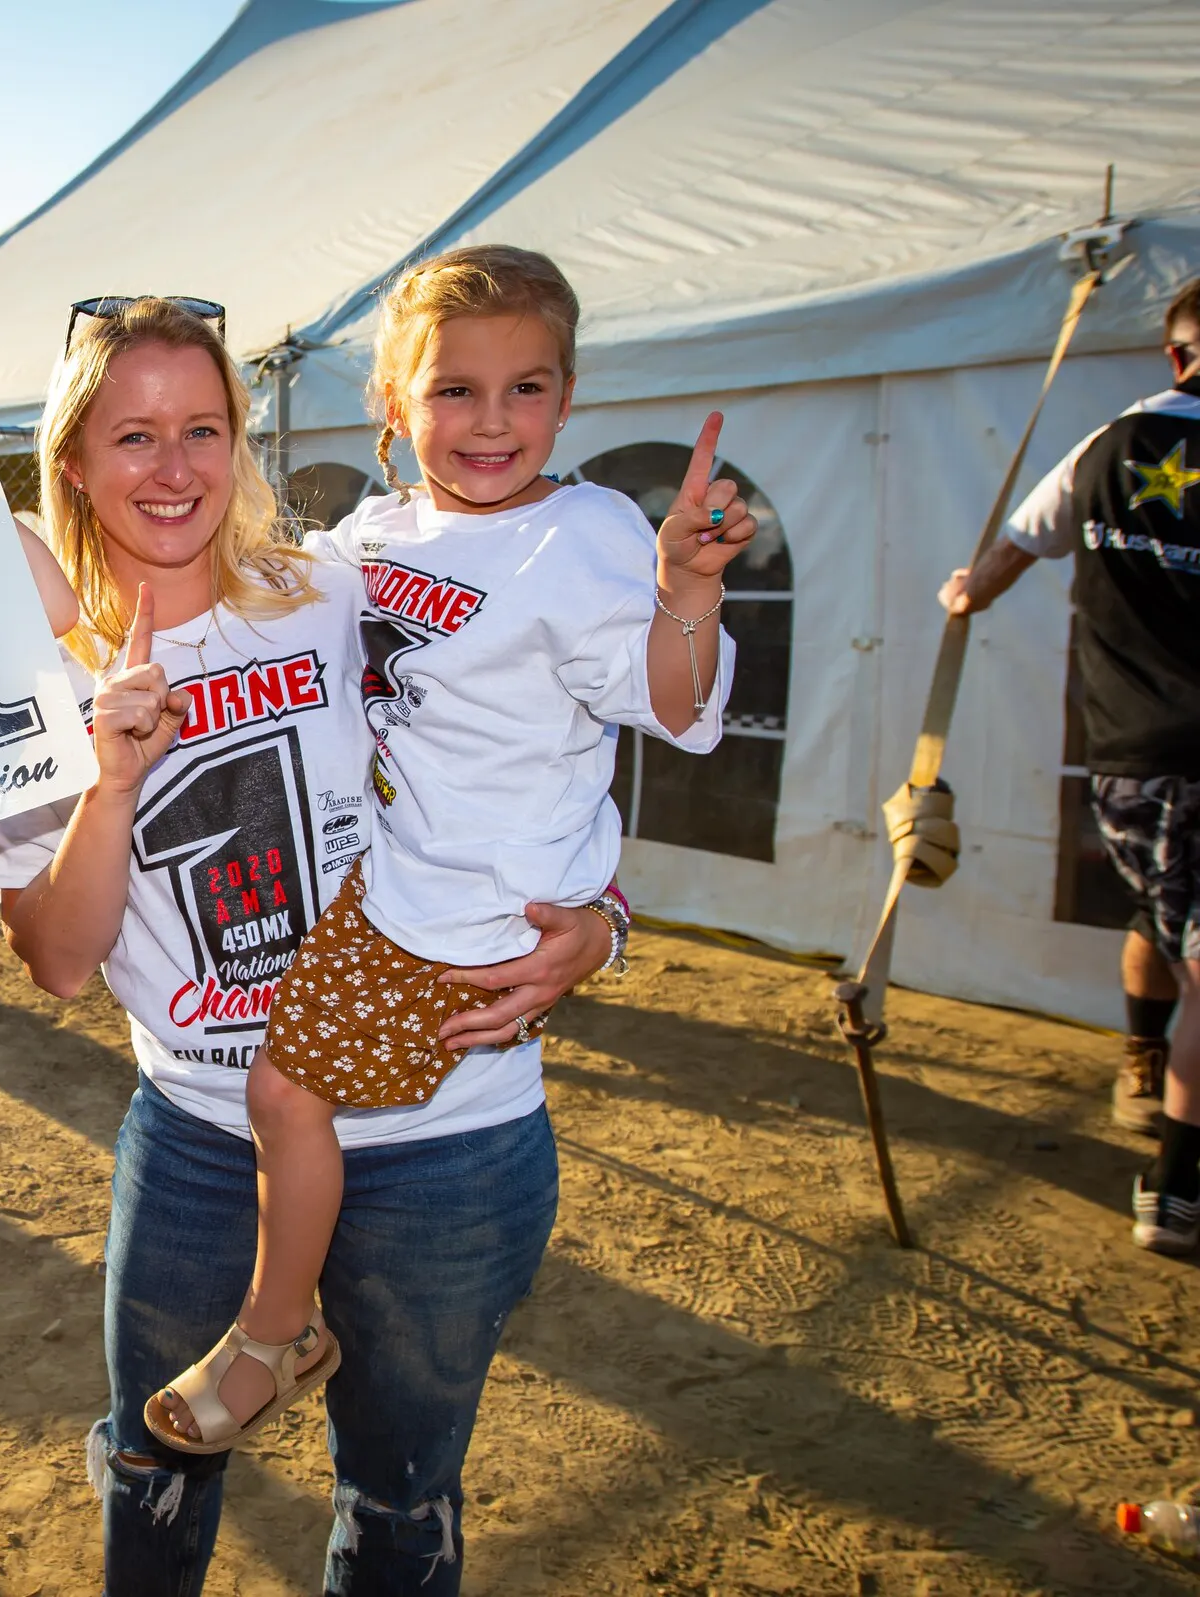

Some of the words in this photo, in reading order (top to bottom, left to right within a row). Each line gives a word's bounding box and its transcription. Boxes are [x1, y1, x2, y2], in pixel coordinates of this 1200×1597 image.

[178, 656, 322, 742] ORNE
[322, 815, 358, 834] FMF
[325, 833, 360, 854] WPS
[208, 847, 283, 895] 2020
[216, 880, 288, 926] AMA
[221, 920, 261, 954] 450
[262, 909, 294, 943] MX
[219, 937, 299, 983] Nationa
